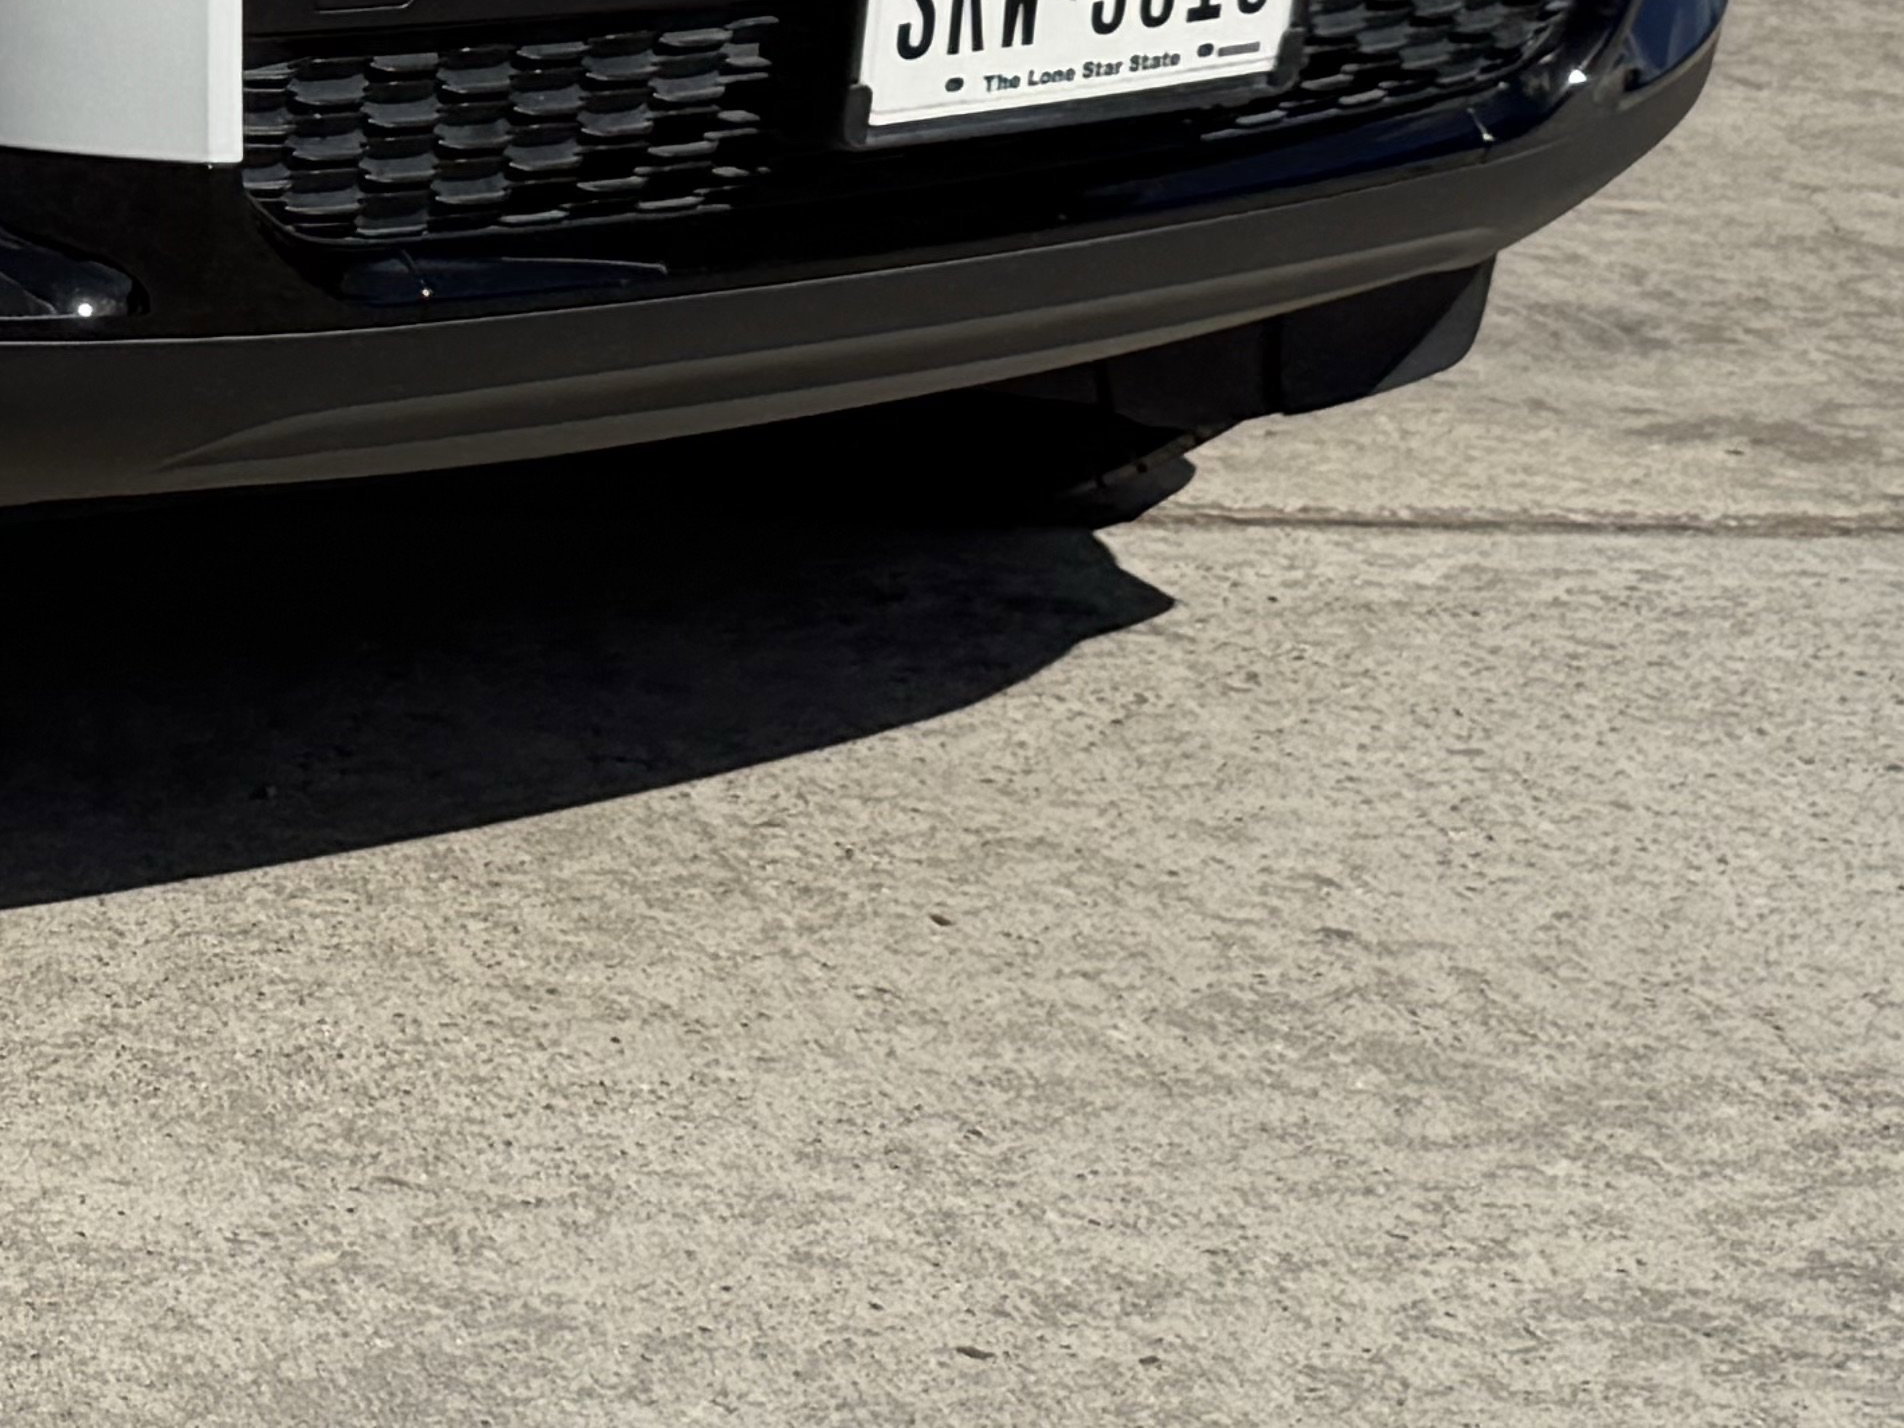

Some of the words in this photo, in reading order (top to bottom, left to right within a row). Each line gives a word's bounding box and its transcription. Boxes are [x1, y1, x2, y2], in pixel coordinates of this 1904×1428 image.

[983, 72, 1021, 93] The
[1028, 65, 1076, 87] Lone
[1081, 58, 1123, 79] Star
[1129, 49, 1181, 73] State
